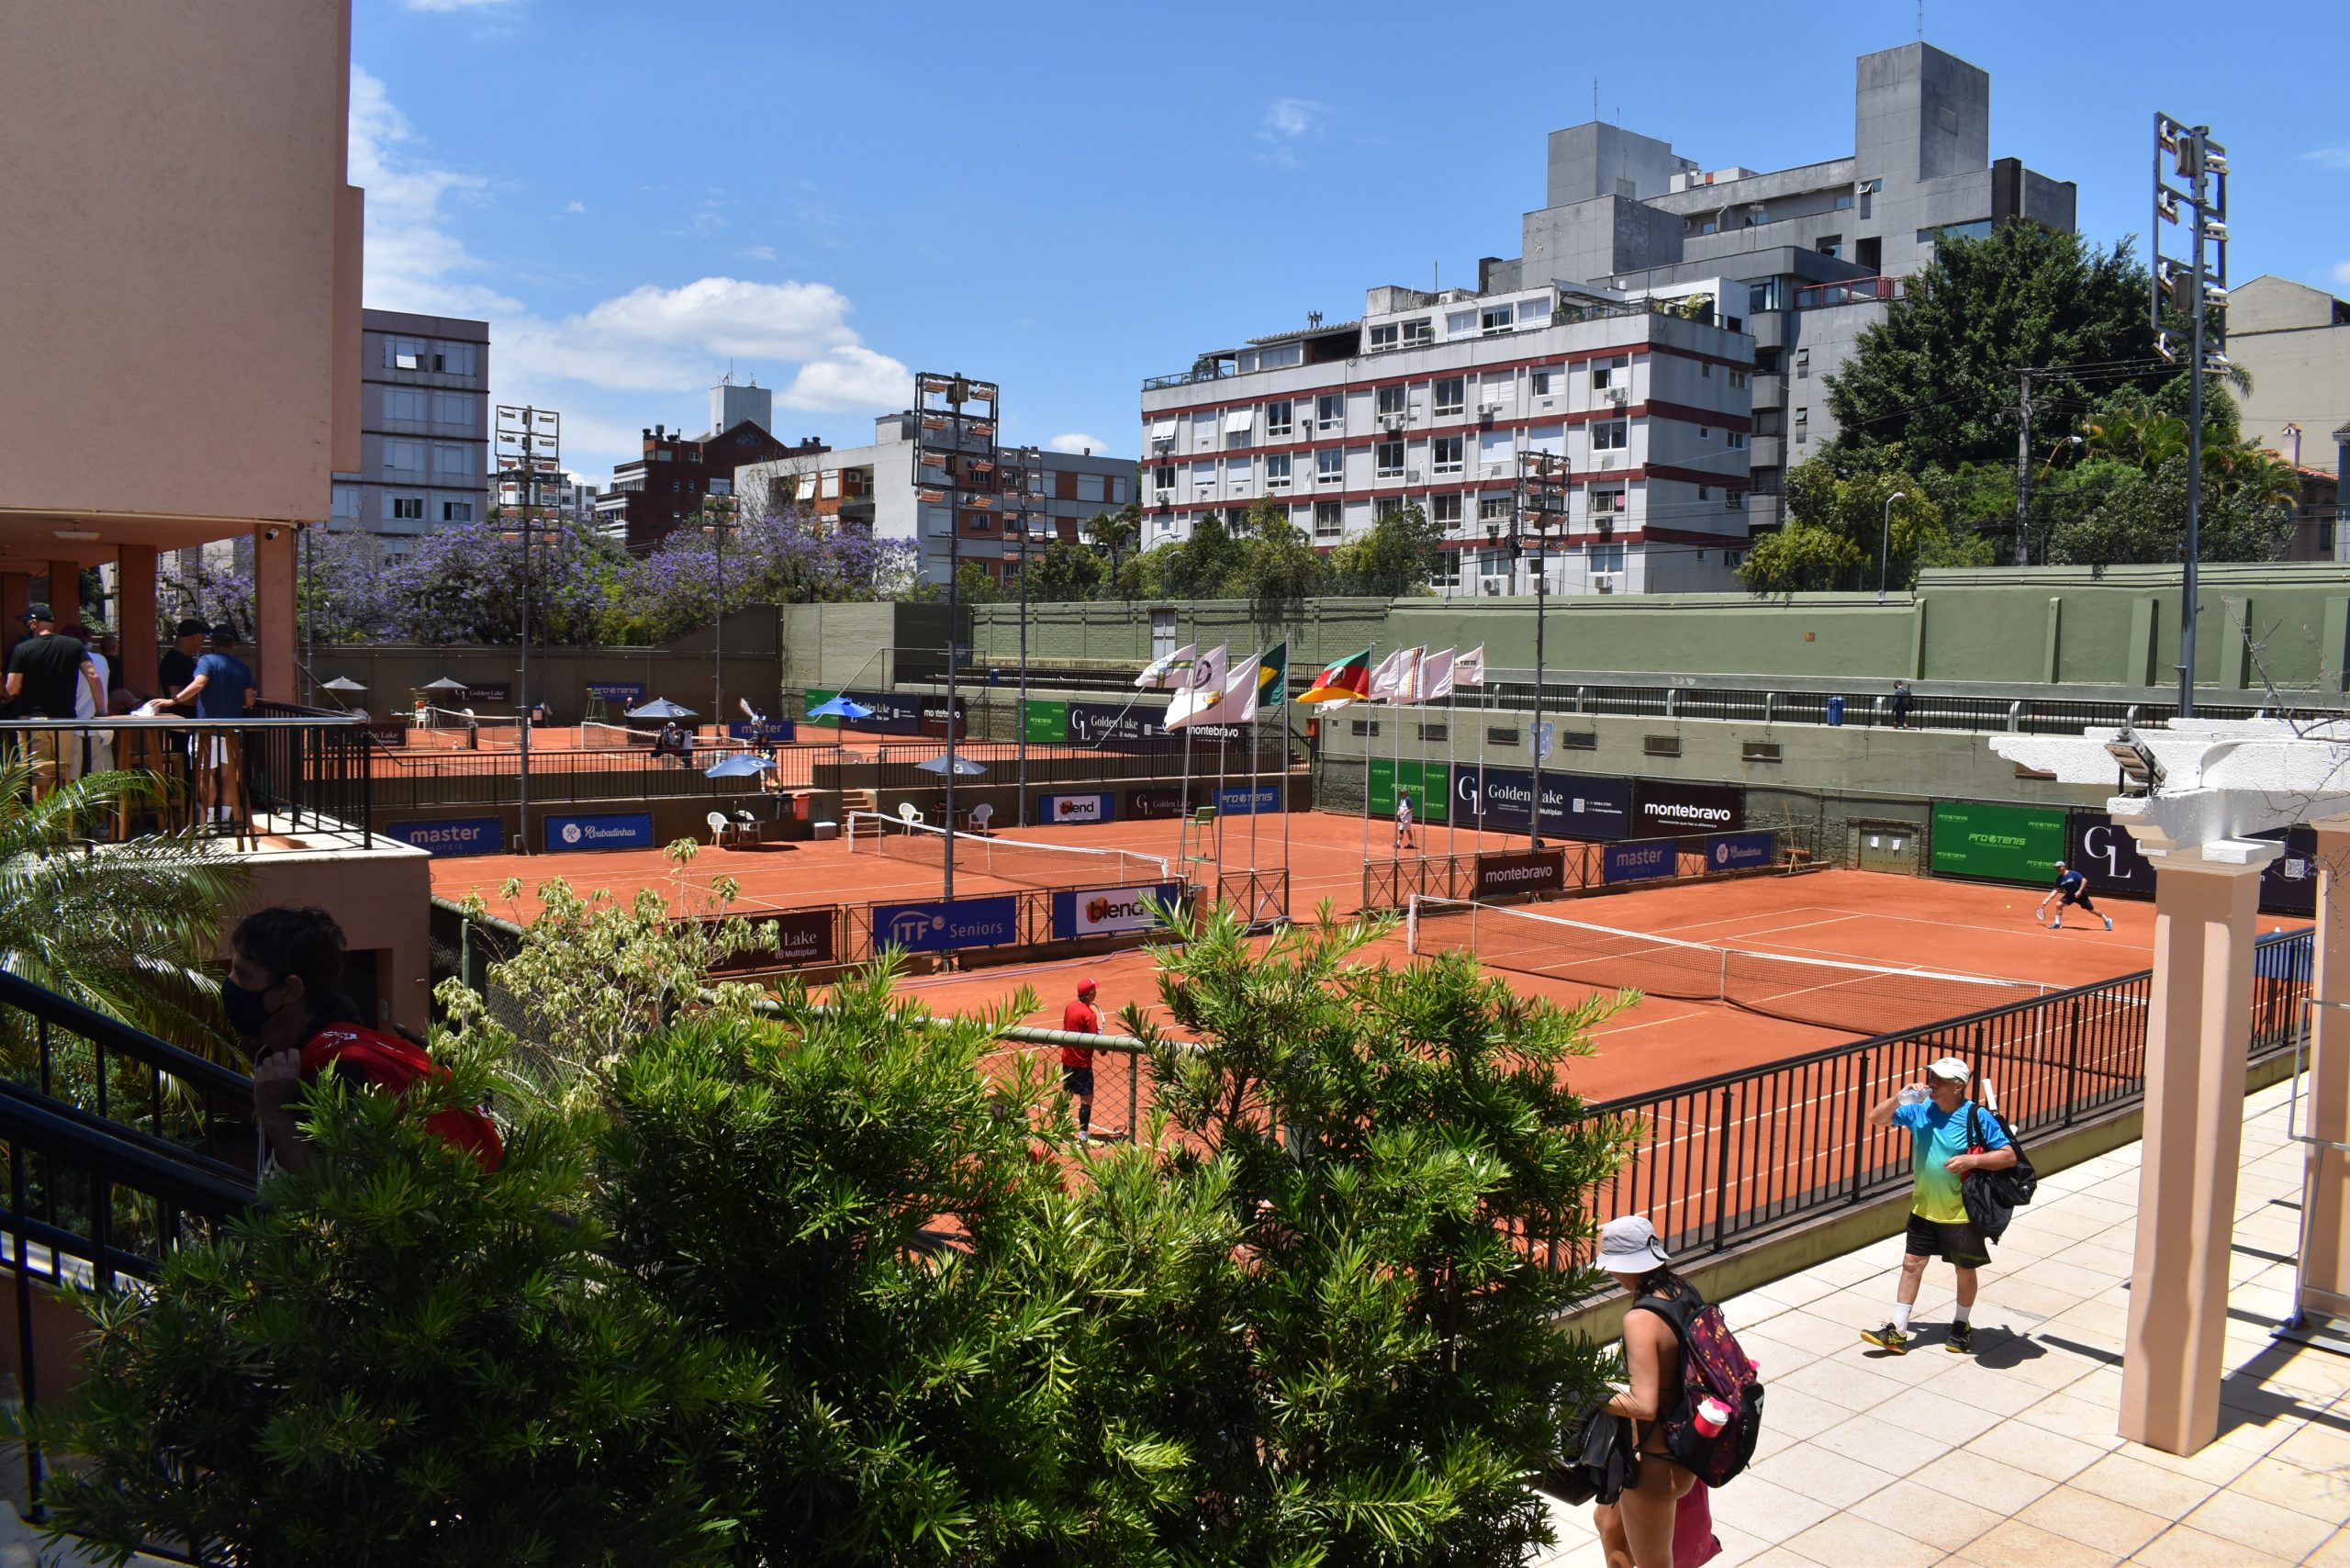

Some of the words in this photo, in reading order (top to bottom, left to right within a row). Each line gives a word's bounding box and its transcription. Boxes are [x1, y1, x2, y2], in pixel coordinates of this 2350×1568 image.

[742, 723, 782, 734] mter
[1091, 715, 1118, 728] Golden
[1488, 783, 1531, 801] Golden
[1542, 790, 1563, 805] ake
[1062, 800, 1094, 814] blend
[1153, 800, 1176, 808] Golden
[1644, 803, 1731, 821] montebravo
[410, 825, 481, 844] master
[584, 825, 636, 839] Roubadinhas
[1617, 848, 1662, 867] master
[1729, 845, 1762, 858] Roubadinhas
[1485, 865, 1553, 883] montebravo
[784, 931, 818, 946] Lake
[892, 921, 928, 942] ITF
[949, 921, 1003, 938] Seniors
[784, 947, 818, 959] Multiplan
